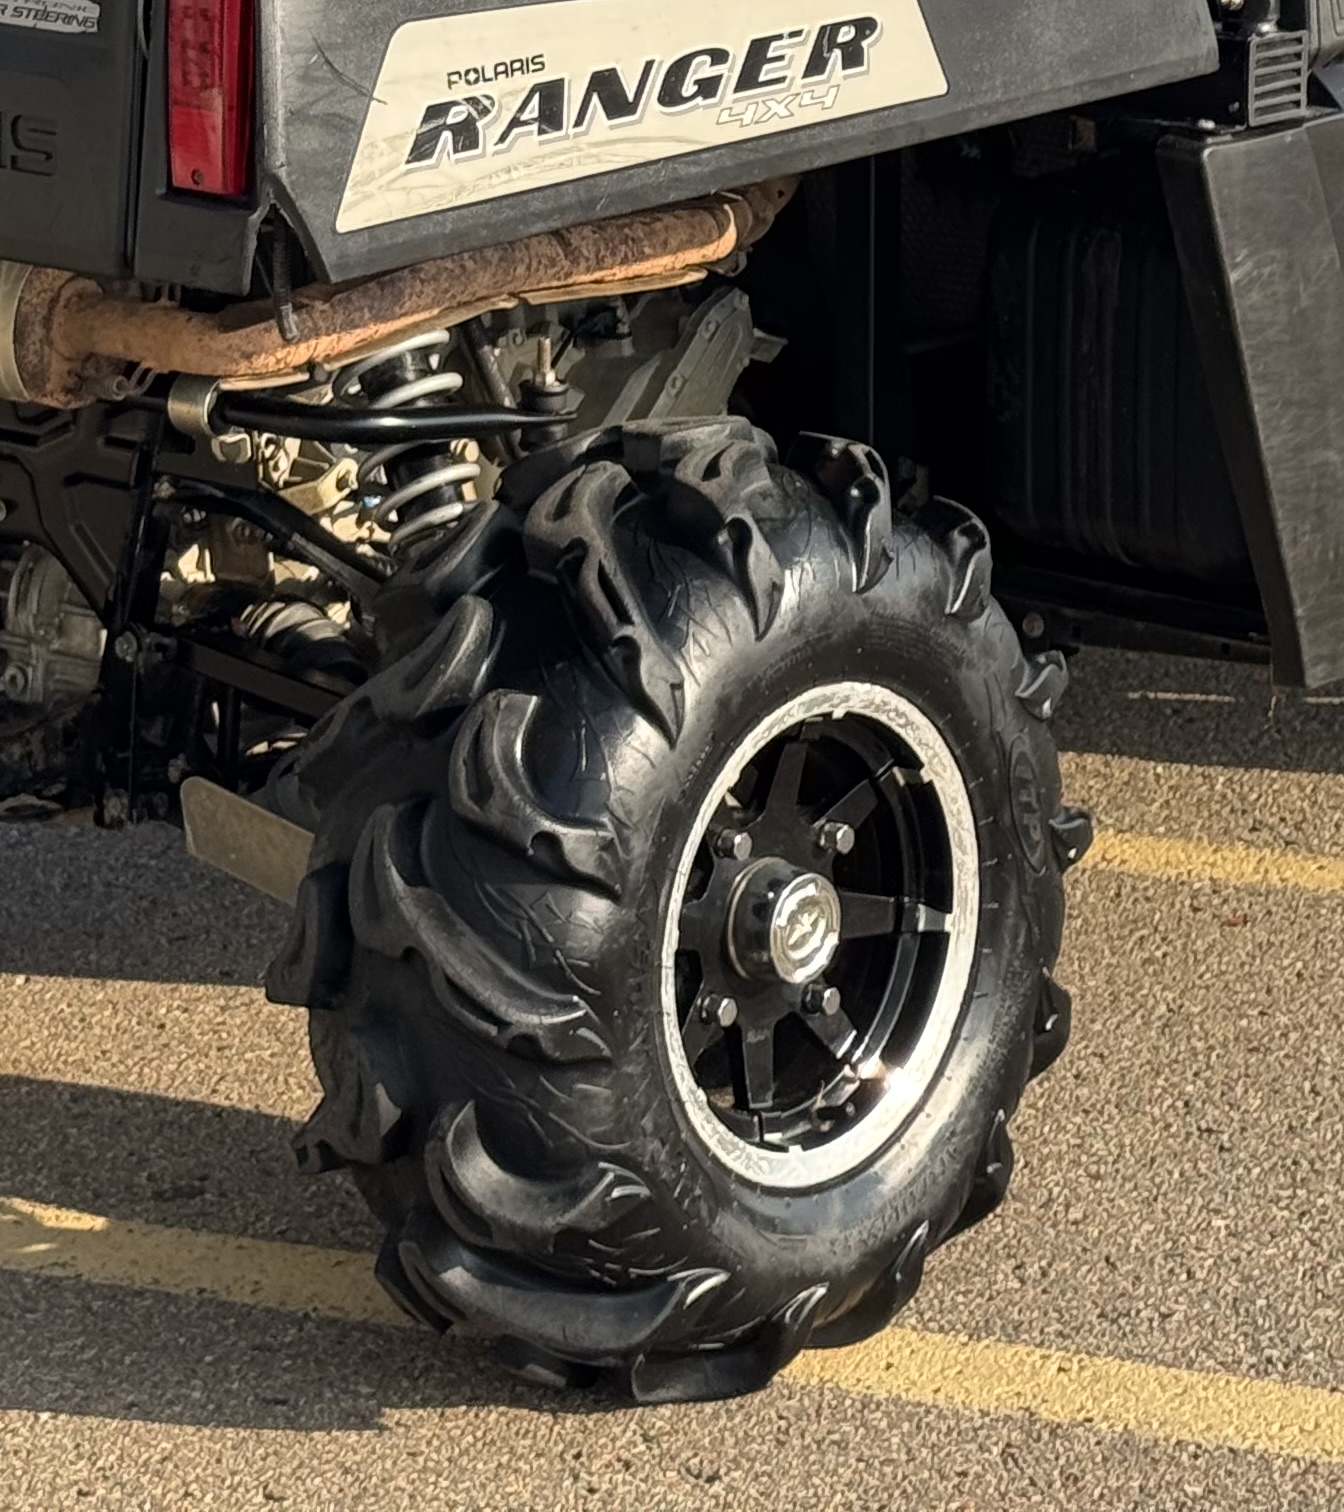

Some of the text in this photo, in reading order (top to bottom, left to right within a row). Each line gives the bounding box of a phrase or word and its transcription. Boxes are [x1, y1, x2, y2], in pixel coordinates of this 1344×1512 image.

[11, 5, 96, 29] STEERING
[445, 53, 546, 90] POLARIS
[405, 16, 880, 166] RANGER
